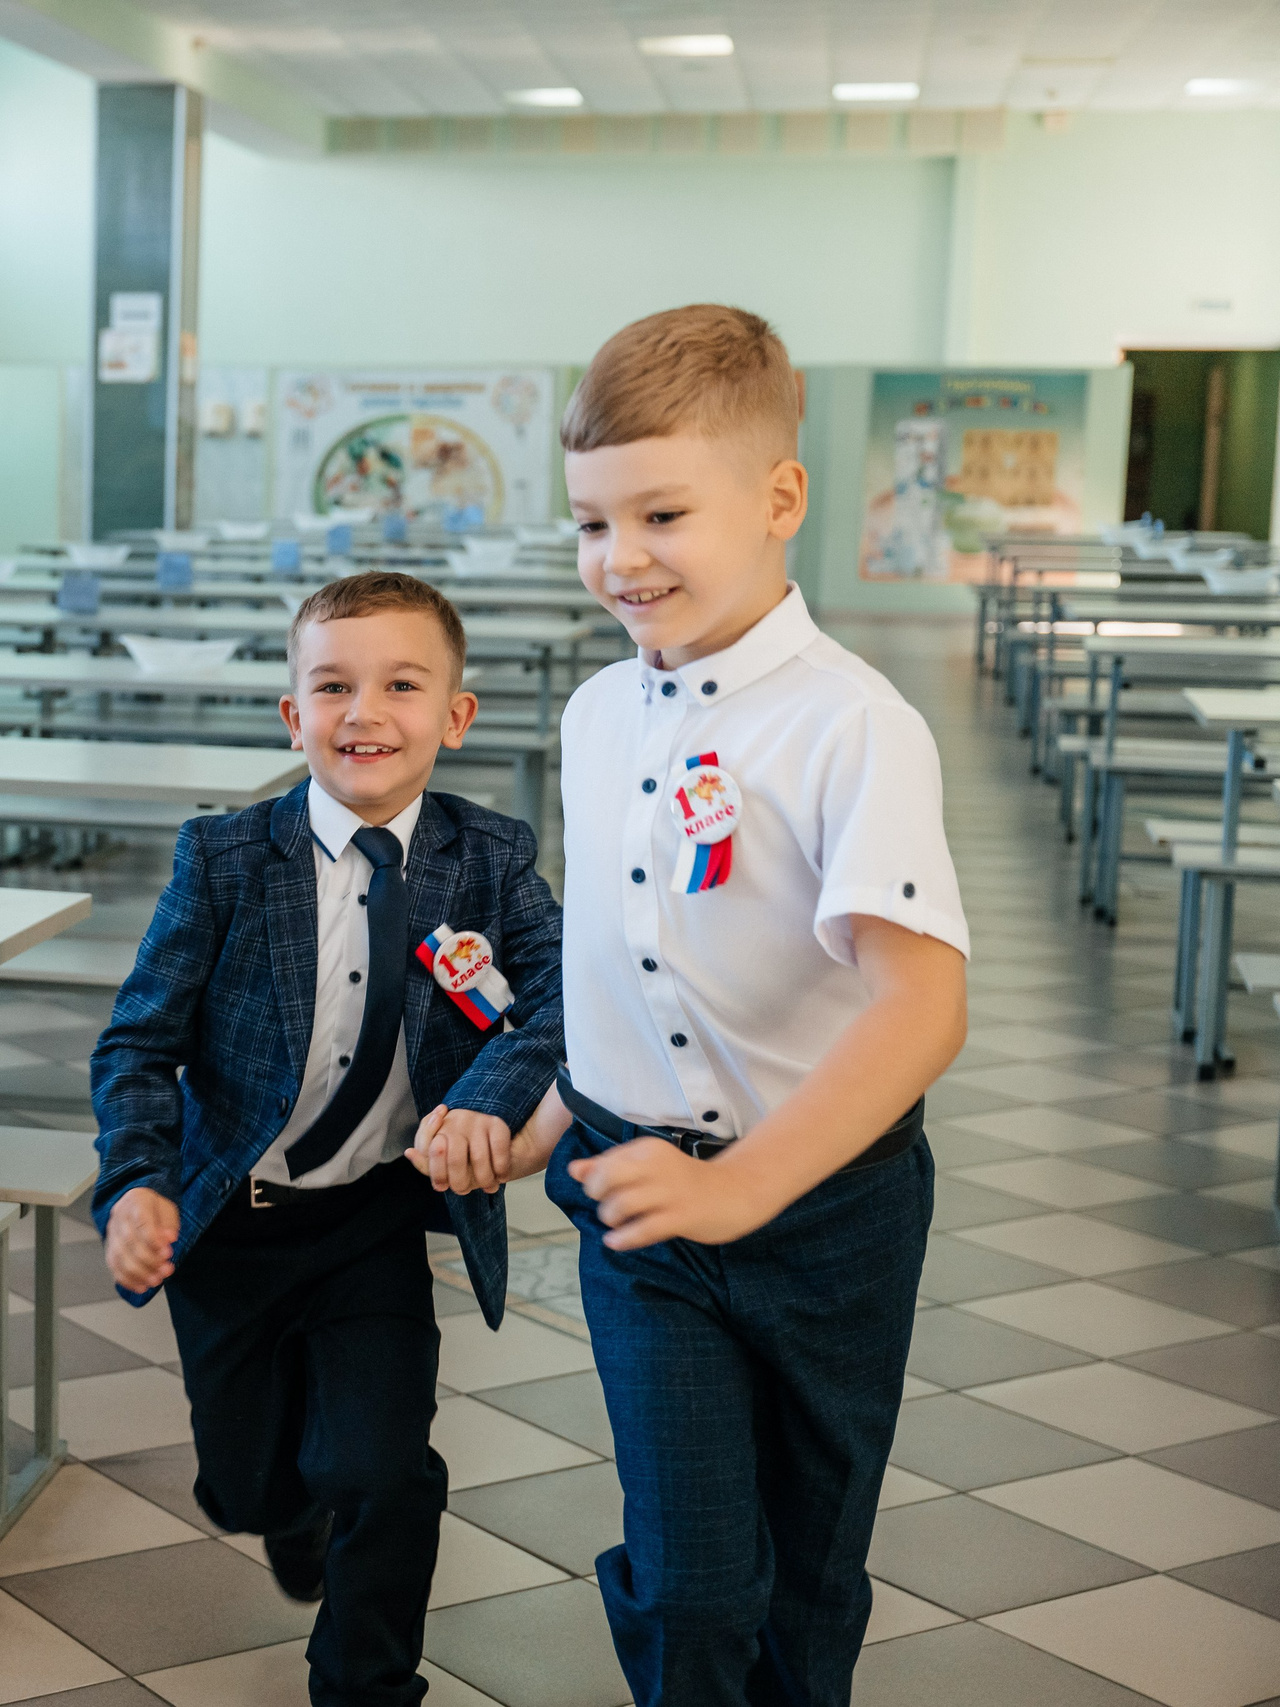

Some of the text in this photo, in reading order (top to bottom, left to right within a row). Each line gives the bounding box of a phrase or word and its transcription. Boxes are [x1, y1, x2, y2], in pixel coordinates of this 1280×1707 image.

[674, 786, 696, 820] 1
[438, 954, 459, 978] 1
[451, 955, 491, 990] класс
